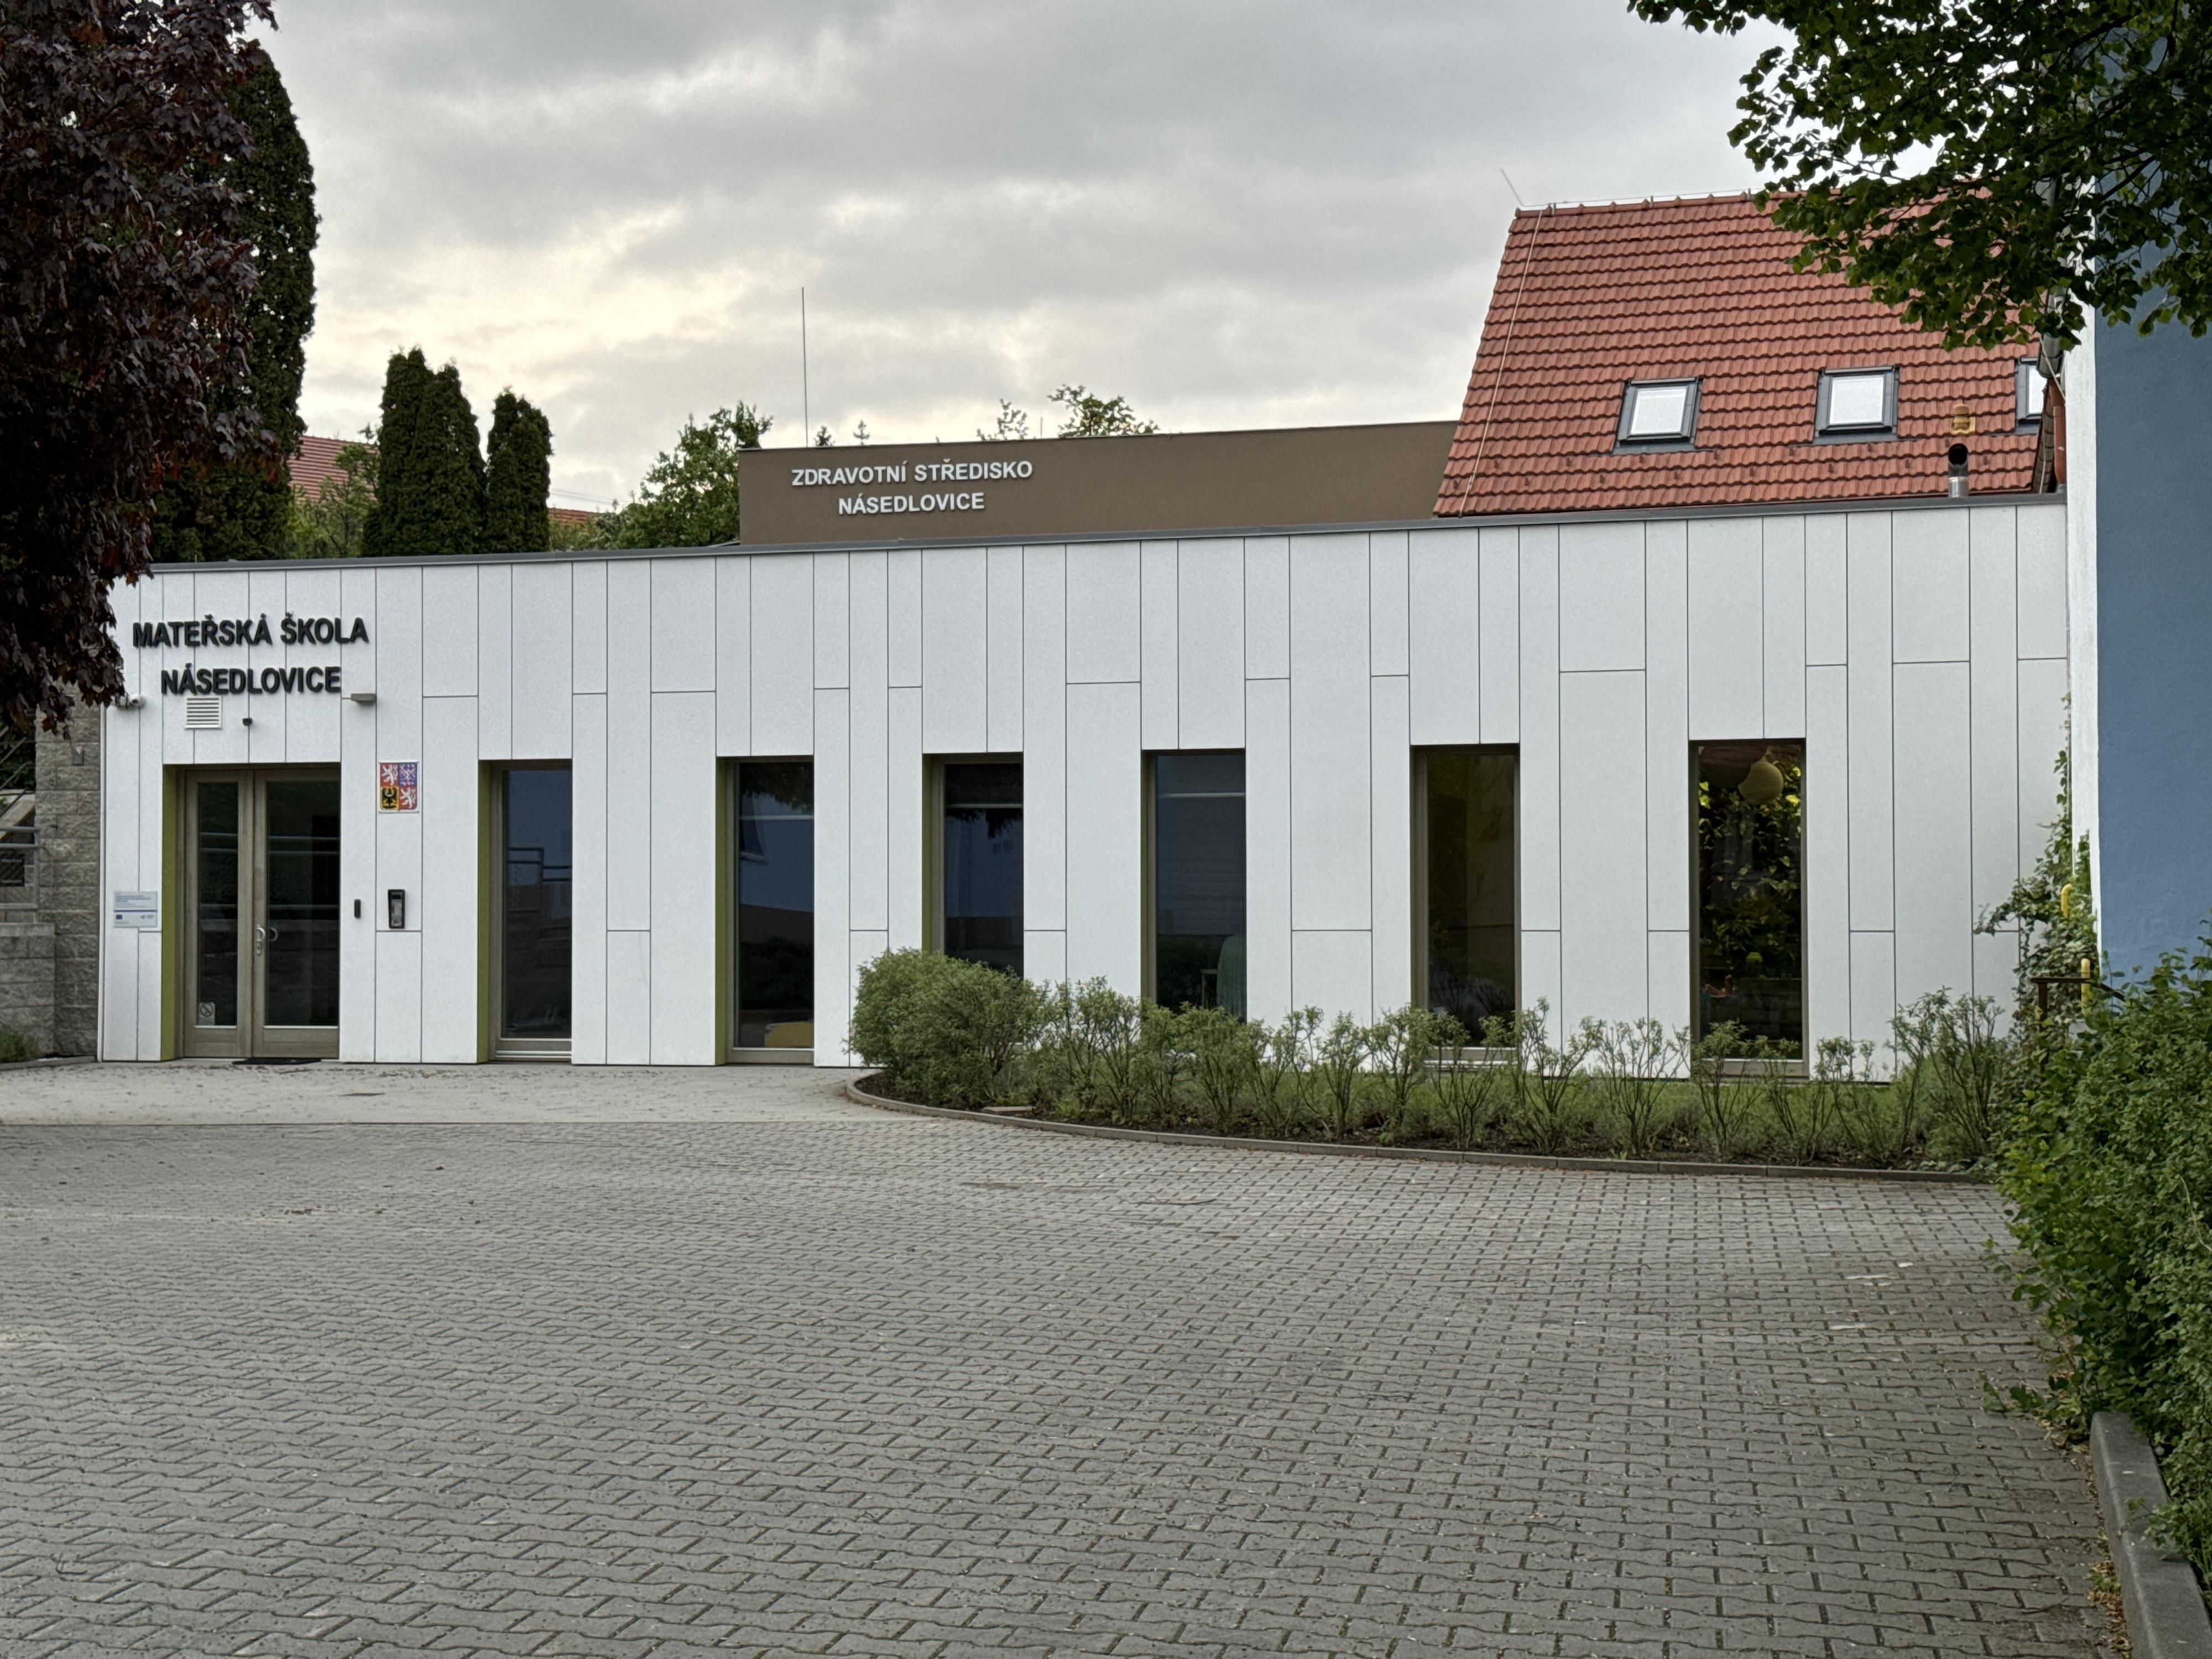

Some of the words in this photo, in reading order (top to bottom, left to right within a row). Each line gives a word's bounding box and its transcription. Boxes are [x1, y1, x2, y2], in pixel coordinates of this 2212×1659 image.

[791, 461, 907, 486] ZDRAVOTNÍ
[914, 458, 1033, 482] STŘEDISKO
[838, 493, 985, 515] NÁSEDLOVICE
[133, 614, 273, 647] MATEŘSKÁ
[280, 611, 369, 644] ŠKOLA
[161, 662, 341, 695] NÁSEDLOVICE
